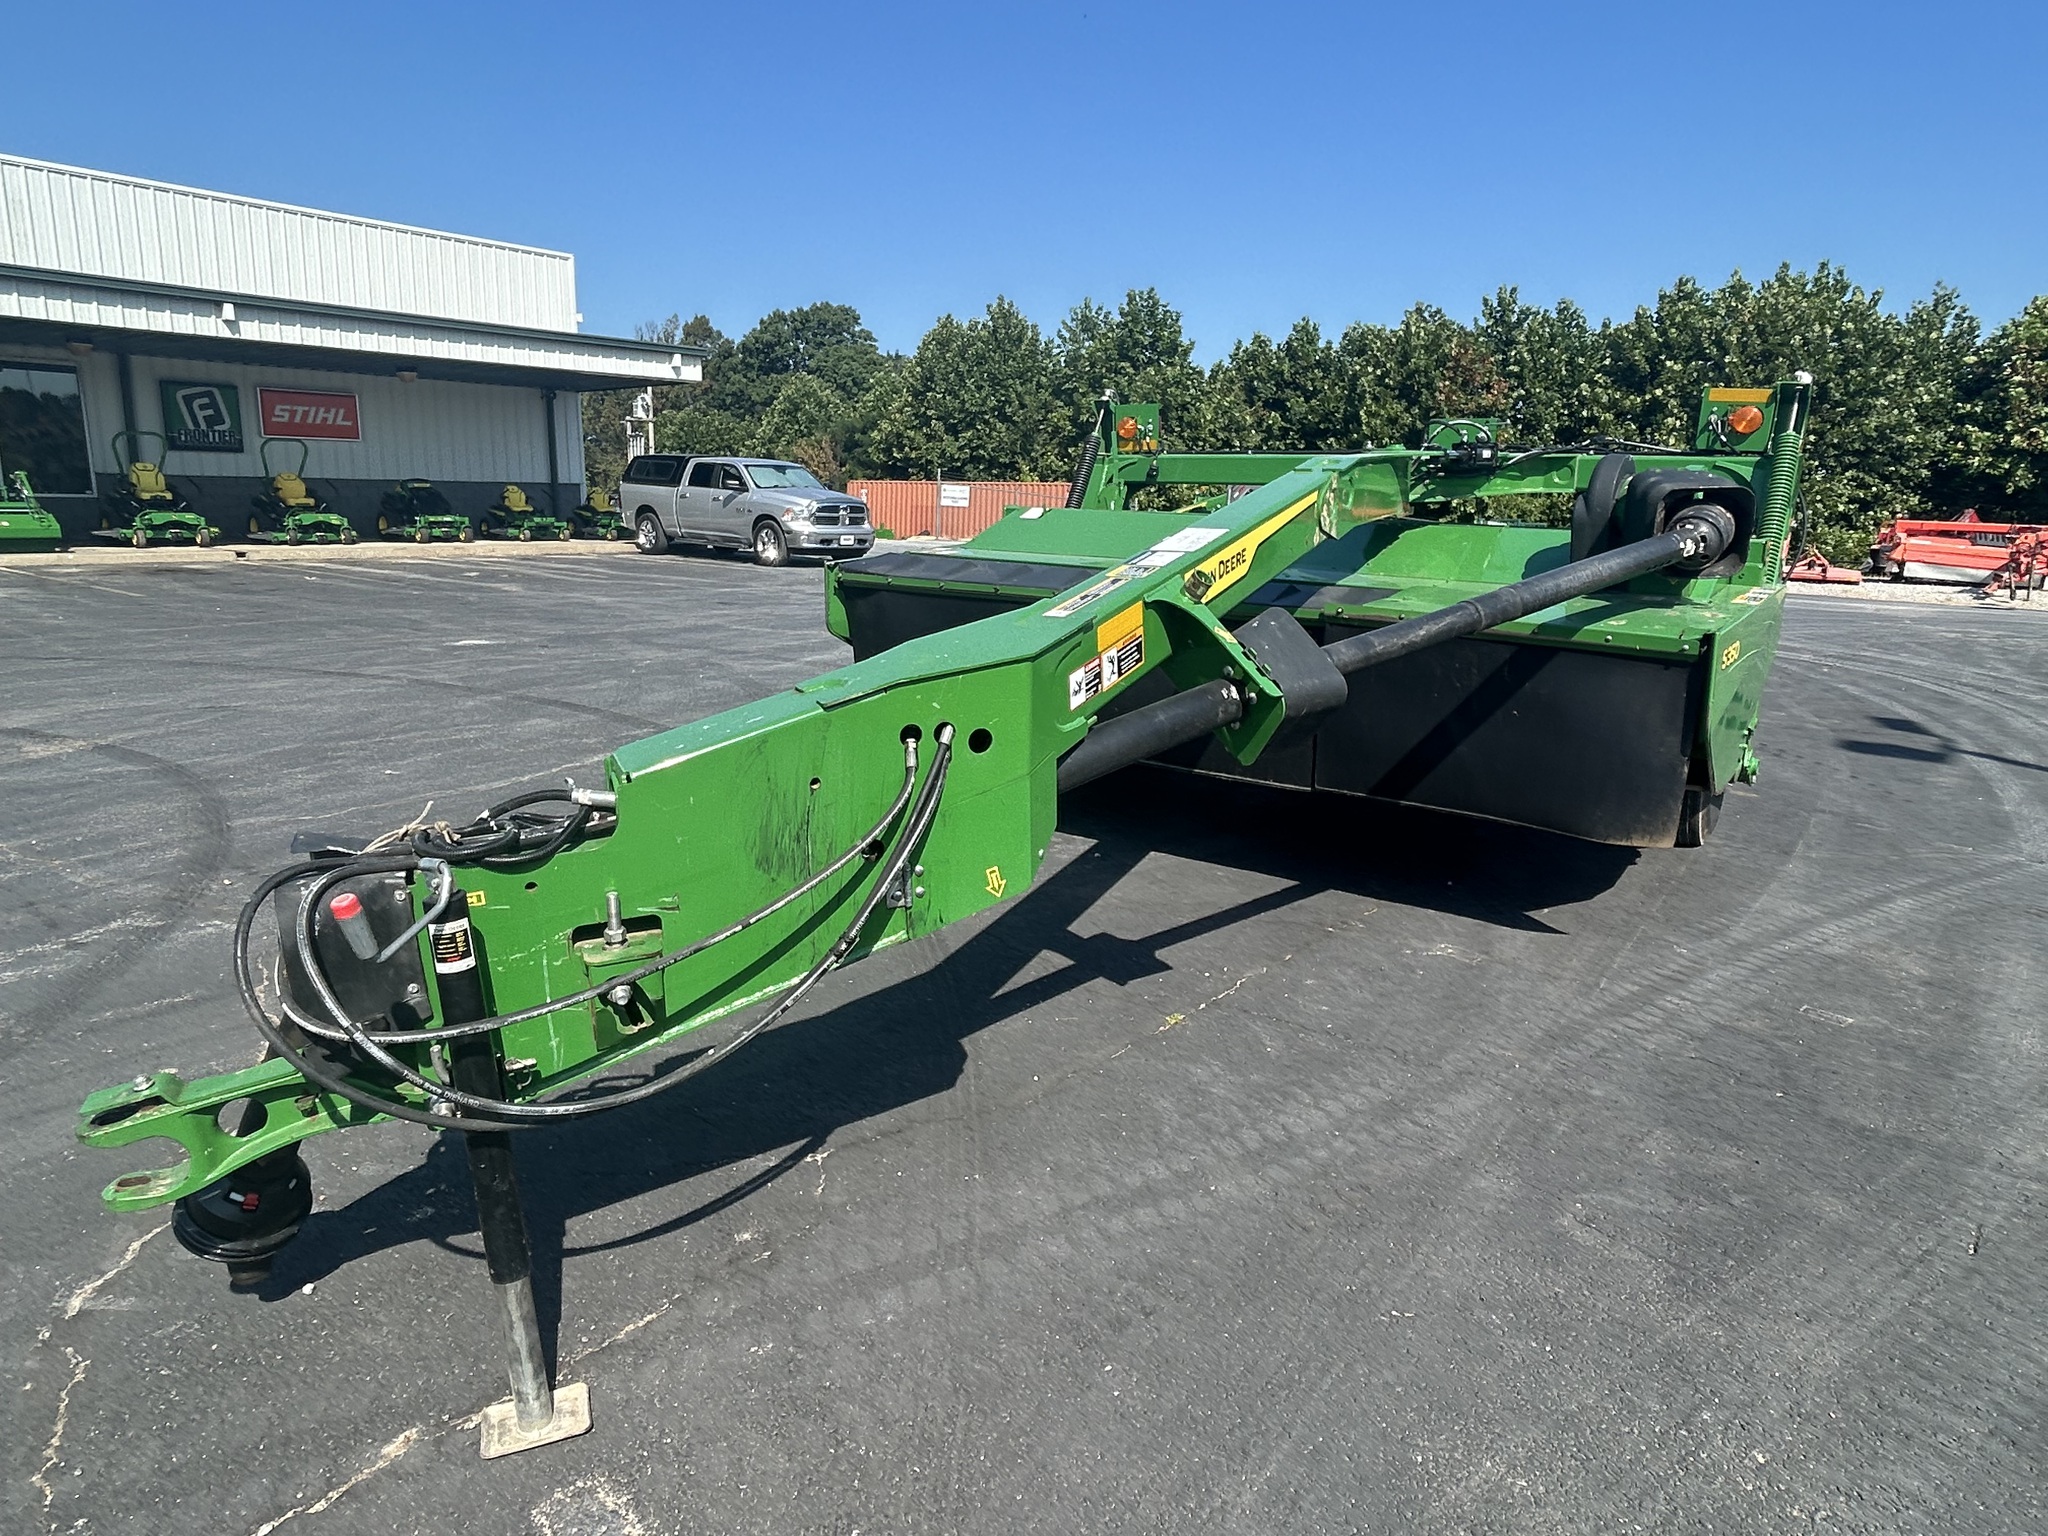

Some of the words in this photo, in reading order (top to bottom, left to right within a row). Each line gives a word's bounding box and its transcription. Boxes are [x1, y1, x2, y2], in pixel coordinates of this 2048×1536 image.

[272, 404, 353, 426] STIHL
[178, 428, 237, 443] FRONTIER
[1218, 547, 1247, 580] DEERE
